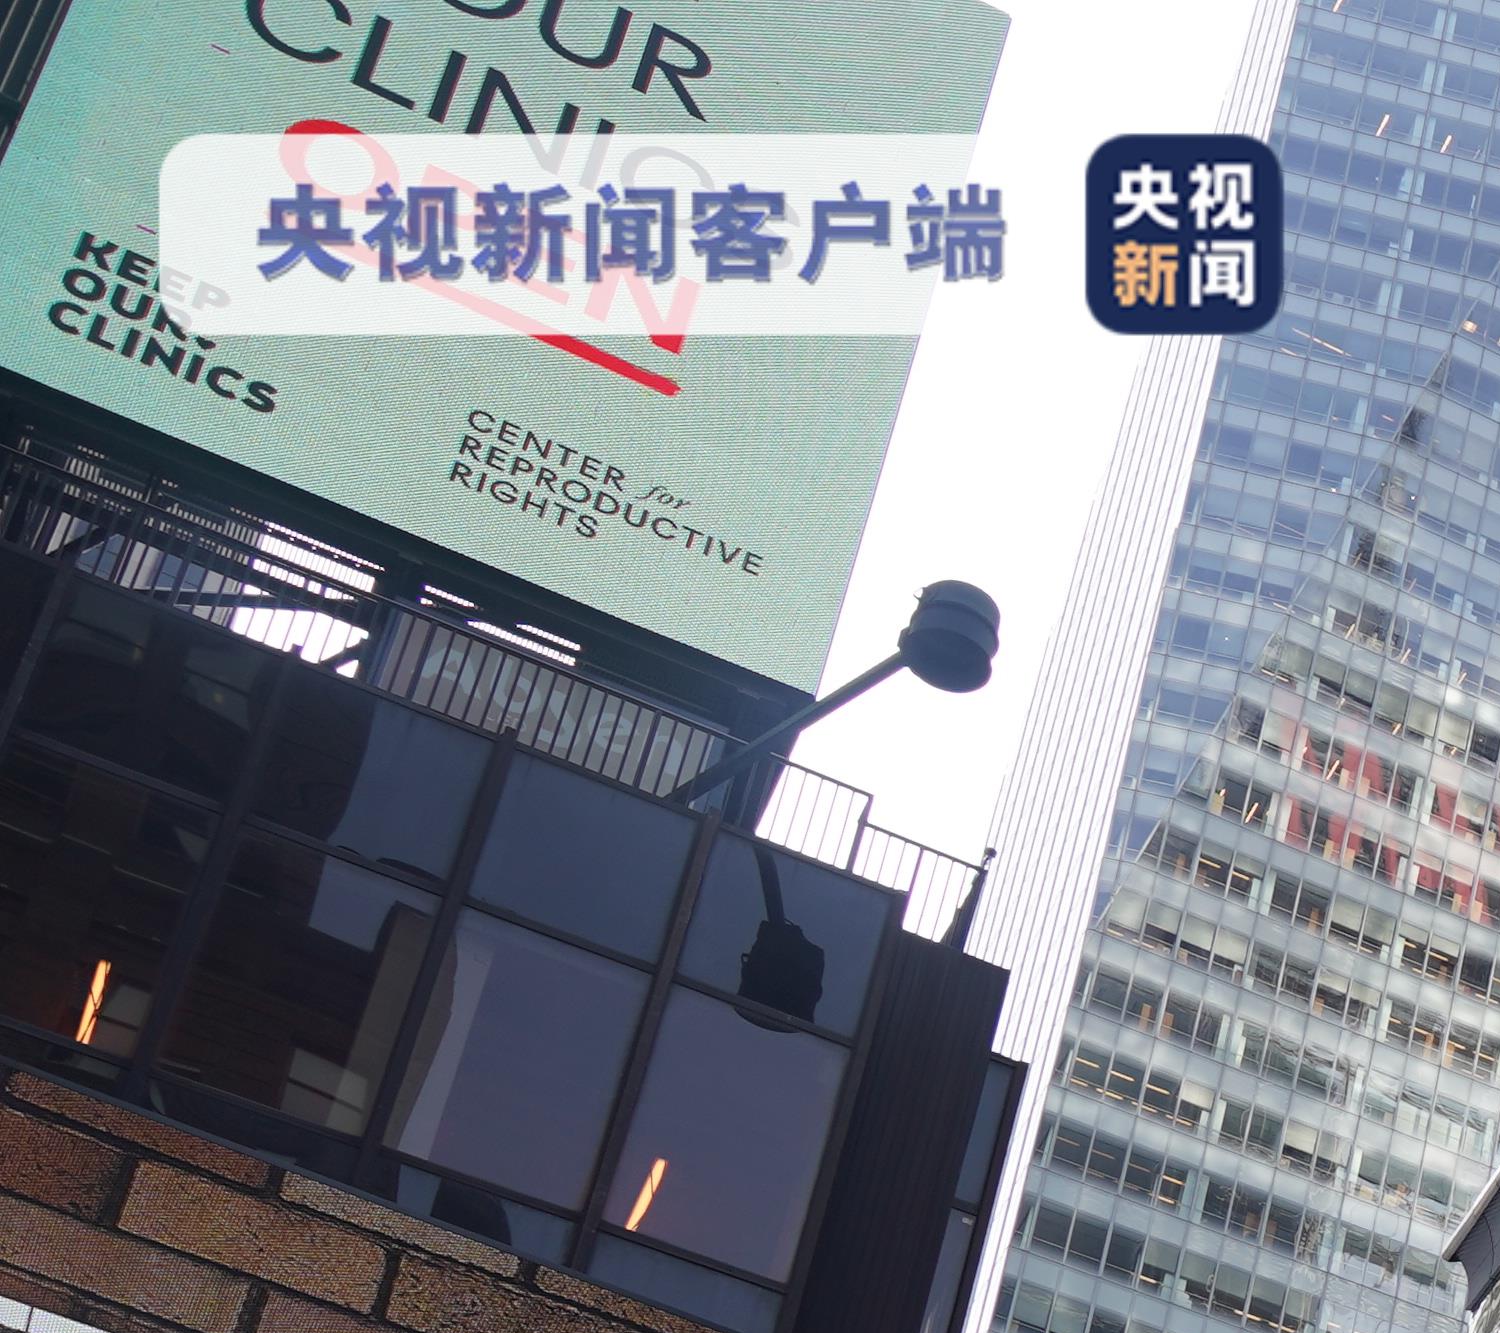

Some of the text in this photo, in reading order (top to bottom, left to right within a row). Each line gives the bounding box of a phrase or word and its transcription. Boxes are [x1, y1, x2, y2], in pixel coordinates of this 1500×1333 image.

[62, 268, 192, 342] OUR
[72, 231, 232, 312] KEEP
[48, 301, 278, 413] CLINICS
[449, 461, 599, 539] RIGHTS
[459, 434, 764, 577] REPRODUCTIVE
[467, 409, 691, 511] CENTER for
